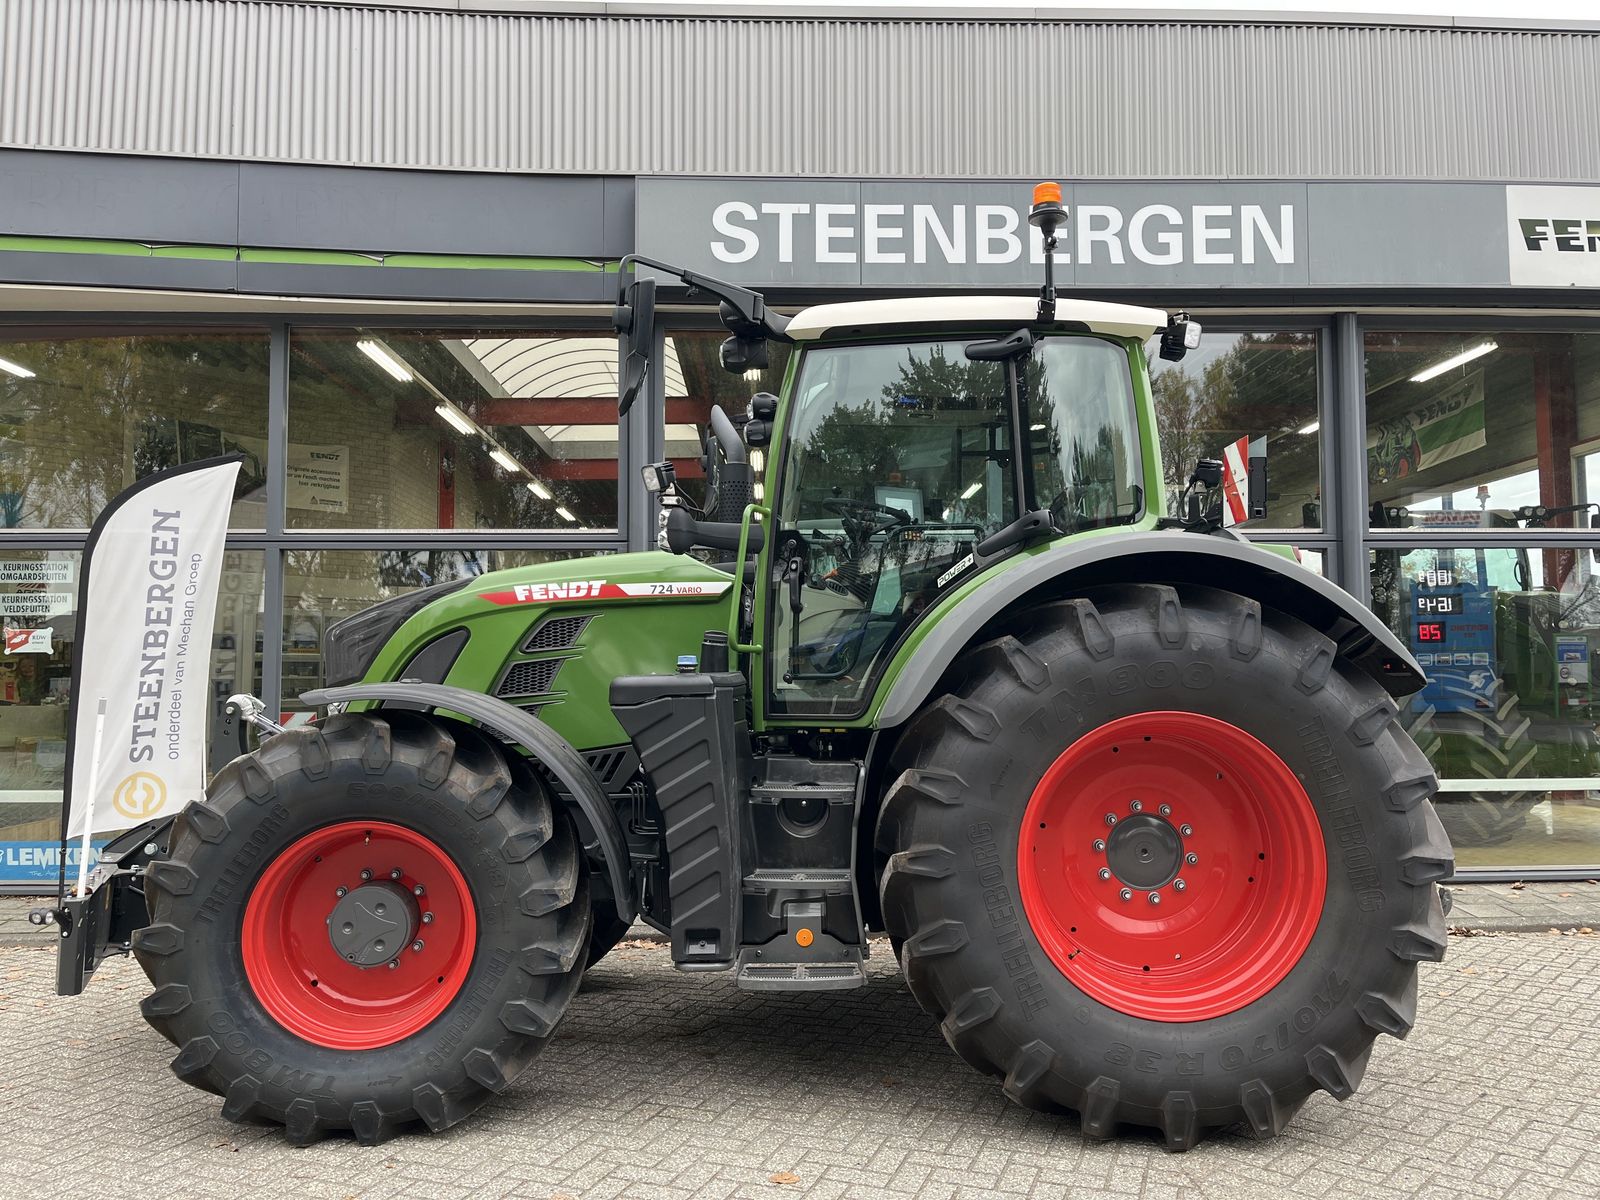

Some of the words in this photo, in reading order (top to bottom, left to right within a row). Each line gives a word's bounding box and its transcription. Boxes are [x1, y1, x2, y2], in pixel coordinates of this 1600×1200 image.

[710, 201, 1295, 265] STEENBERGEN
[0, 572, 67, 581] OMGAARDSPUITEN
[3, 563, 69, 572] KEURINGSSTATION
[184, 553, 203, 596] Groep
[2, 595, 68, 604] KEURINGSSTATION
[4, 604, 50, 613] VELDSPUITEN
[513, 579, 608, 602] FENDT
[650, 584, 674, 595] 724
[676, 586, 703, 595] VARIO
[129, 509, 181, 763] STEENBERGEN
[175, 600, 195, 657] Mechan
[173, 660, 186, 686] van
[166, 689, 182, 760] onderdeel
[1296, 714, 1386, 913] TRELLEBORG
[6, 847, 103, 870] LEMKEN
[195, 802, 291, 924] TRELLEBORG
[967, 820, 1049, 1022] TRELLEBORG
[430, 947, 513, 1074] TRELLEBORG
